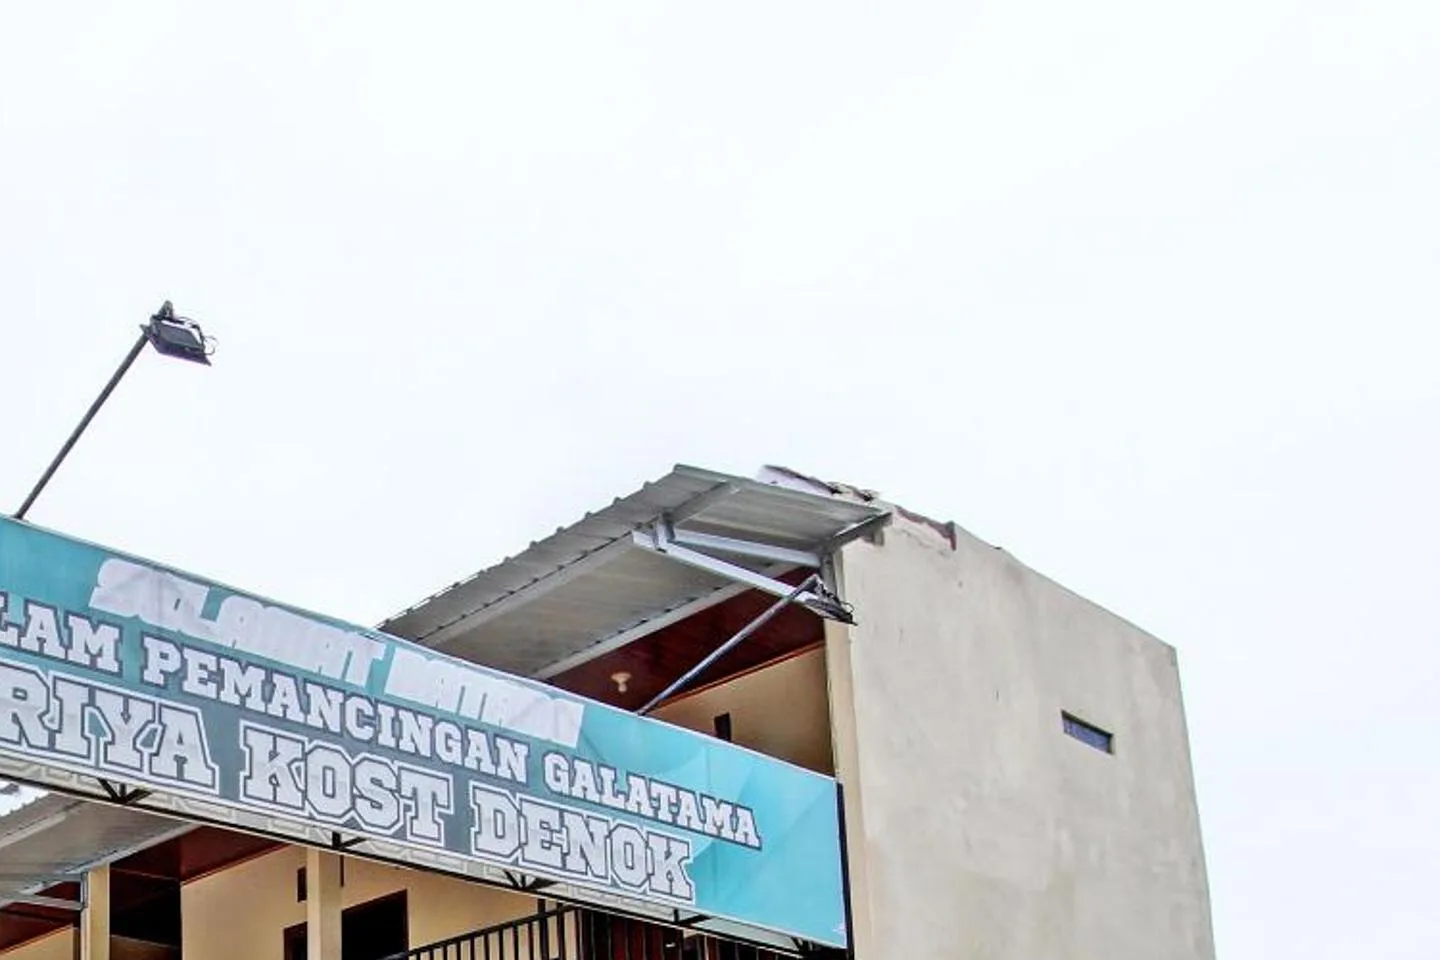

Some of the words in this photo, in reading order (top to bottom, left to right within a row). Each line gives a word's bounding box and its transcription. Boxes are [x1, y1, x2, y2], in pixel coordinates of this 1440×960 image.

[141, 632, 530, 784] PEMANCINGAN
[542, 751, 762, 851] GALATAMA
[240, 719, 453, 847] KOST
[469, 781, 695, 903] DENOK
